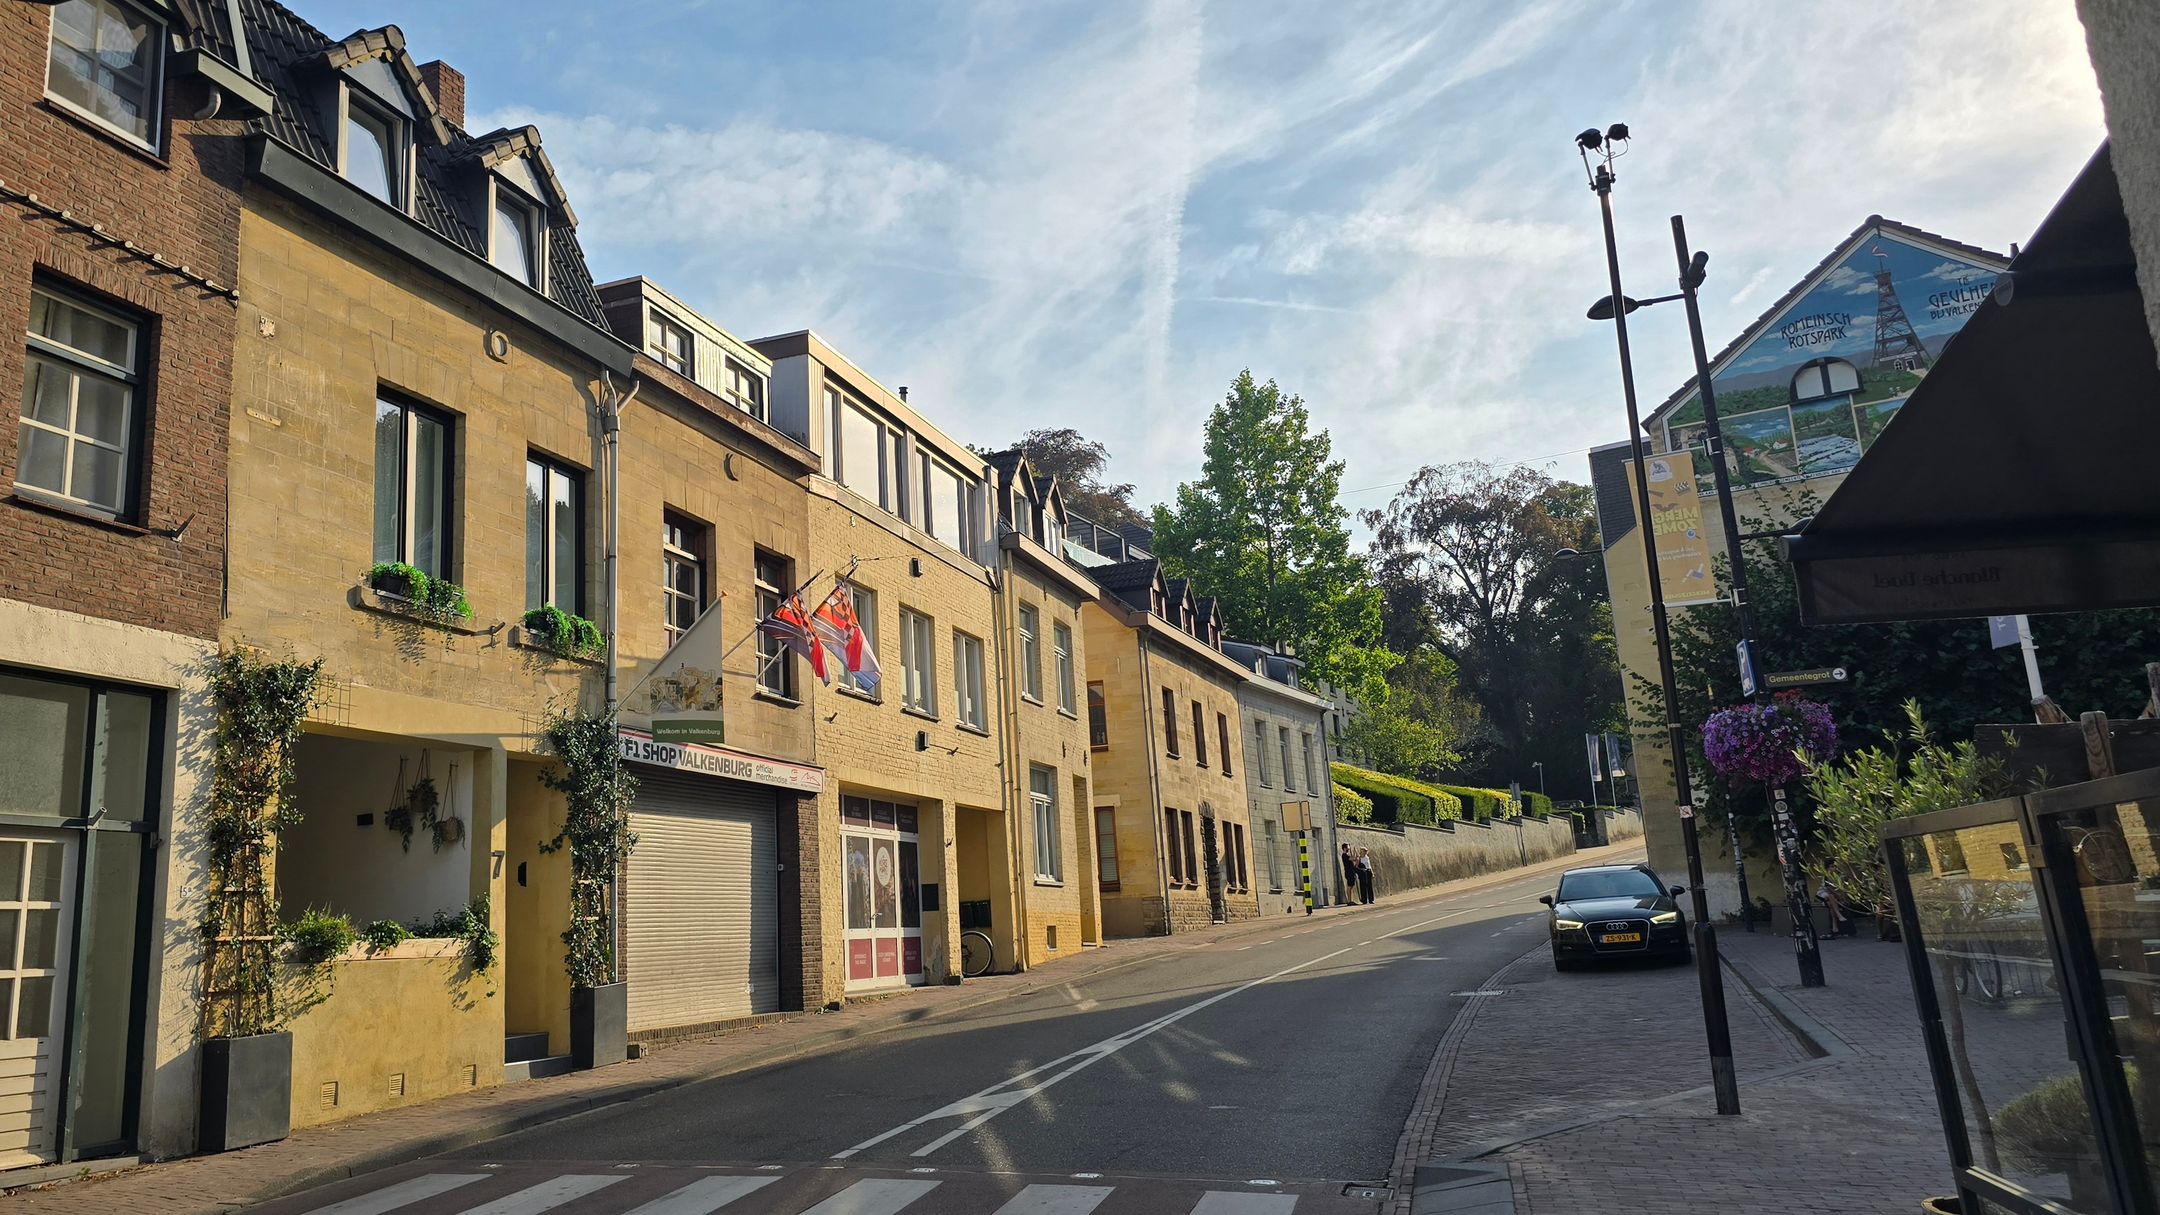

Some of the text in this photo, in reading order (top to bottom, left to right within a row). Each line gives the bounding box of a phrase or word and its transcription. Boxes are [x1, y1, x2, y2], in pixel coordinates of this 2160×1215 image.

[1944, 302, 1982, 316] VALKEN
[1781, 313, 1852, 339] ROMEINSCH
[1789, 326, 1847, 349] ROTSPARK
[1769, 671, 1831, 683] Gemeentegrot
[689, 728, 721, 736] Valkenburg
[625, 738, 752, 778] F1 SHOP VALKENBURG
[756, 764, 773, 774] official
[756, 773, 788, 784] merchandise
[491, 850, 505, 879] 7
